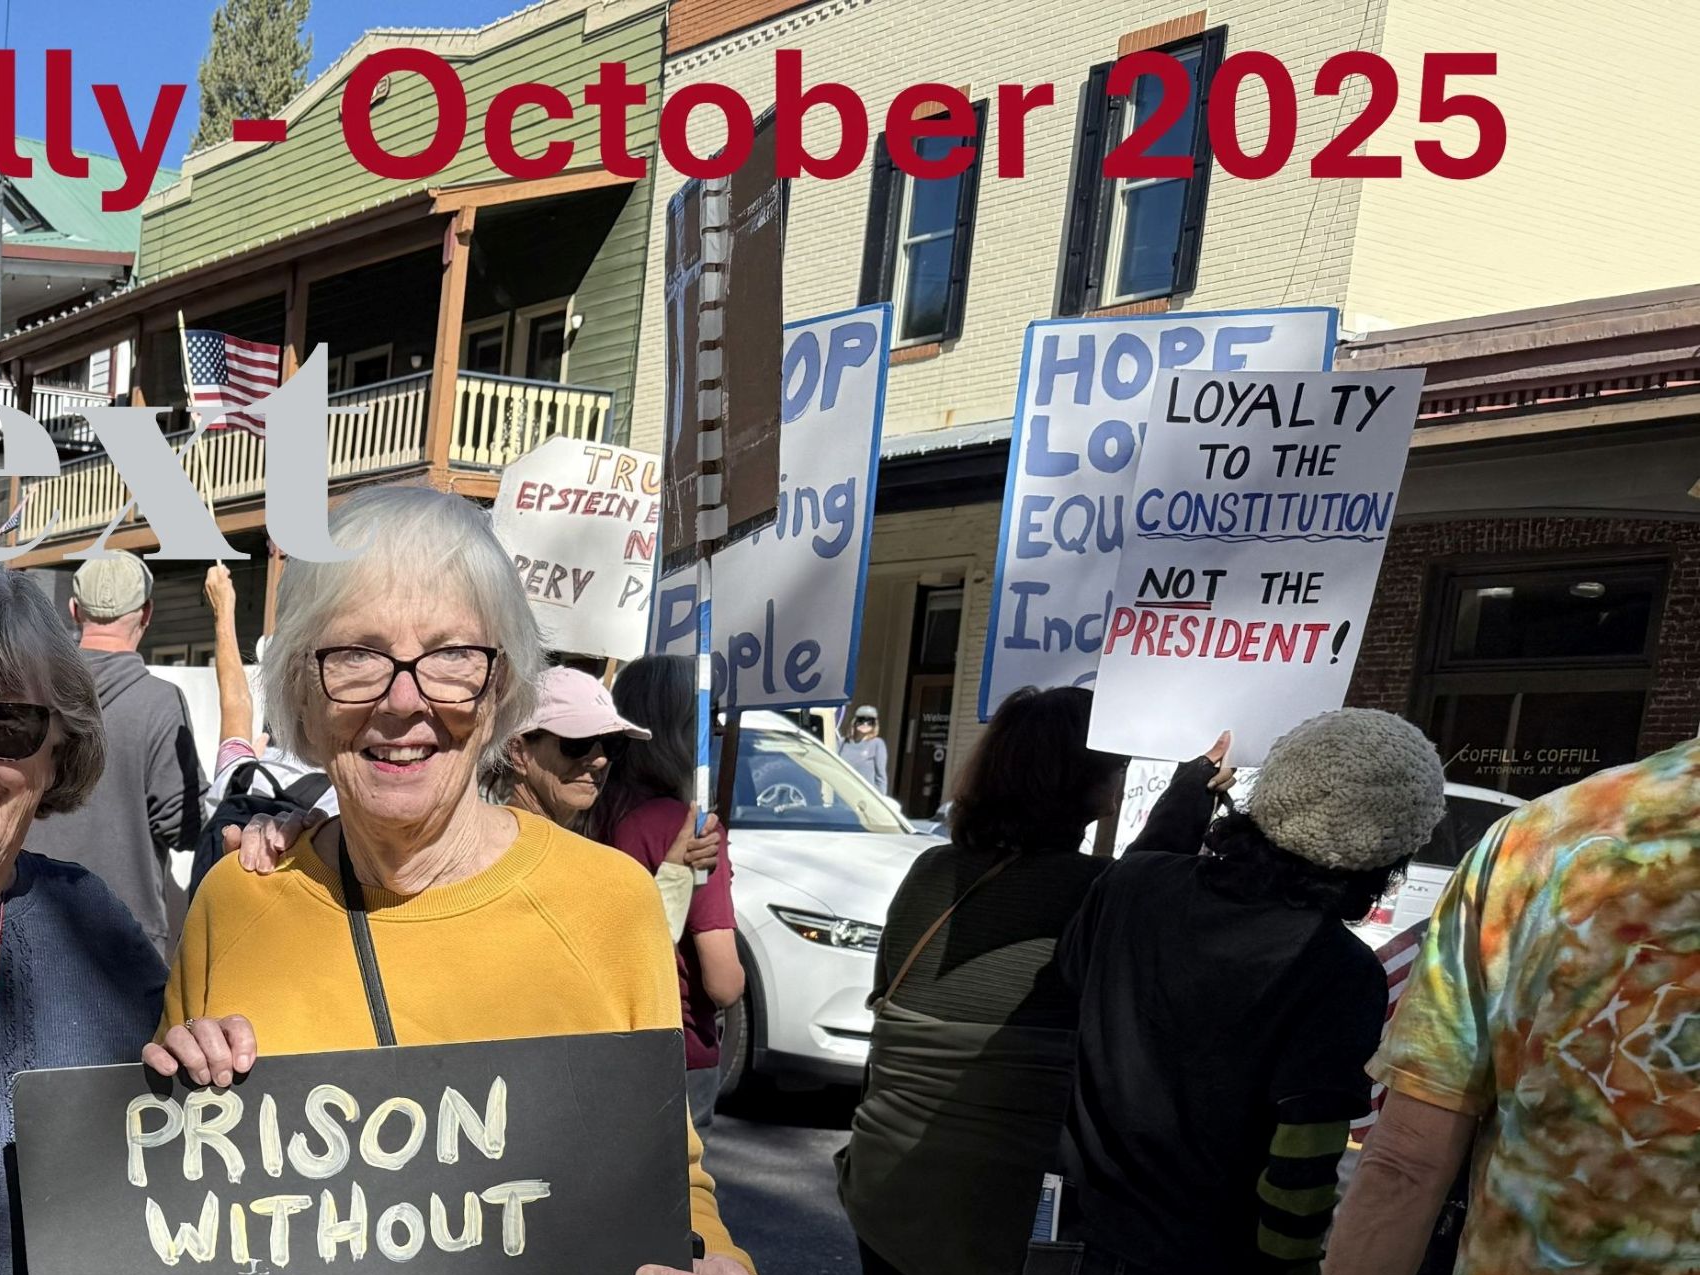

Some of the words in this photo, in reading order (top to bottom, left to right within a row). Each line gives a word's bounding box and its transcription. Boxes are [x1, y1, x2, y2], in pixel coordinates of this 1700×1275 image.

[782, 321, 878, 425] OP
[1166, 377, 1396, 433] LOYALTY
[1025, 415, 1147, 477] LO
[1198, 443, 1251, 480] TO
[1272, 444, 1342, 479] THE
[515, 481, 640, 523] EPSTEIN
[754, 476, 857, 560] ing
[1135, 488, 1395, 536] CONSTITUTION
[1137, 566, 1228, 602] NOT
[1260, 571, 1325, 605] THE
[1103, 606, 1352, 665] PRESIDENT!
[1458, 749, 1520, 763] COFFILL
[1536, 749, 1601, 763] COFFILL
[1474, 765, 1535, 776] ATTORNEYS
[1539, 765, 1553, 776] AT
[1557, 766, 1582, 776] LAW
[125, 1075, 508, 1188] PRISON
[145, 1178, 552, 1268] WITHOUT
